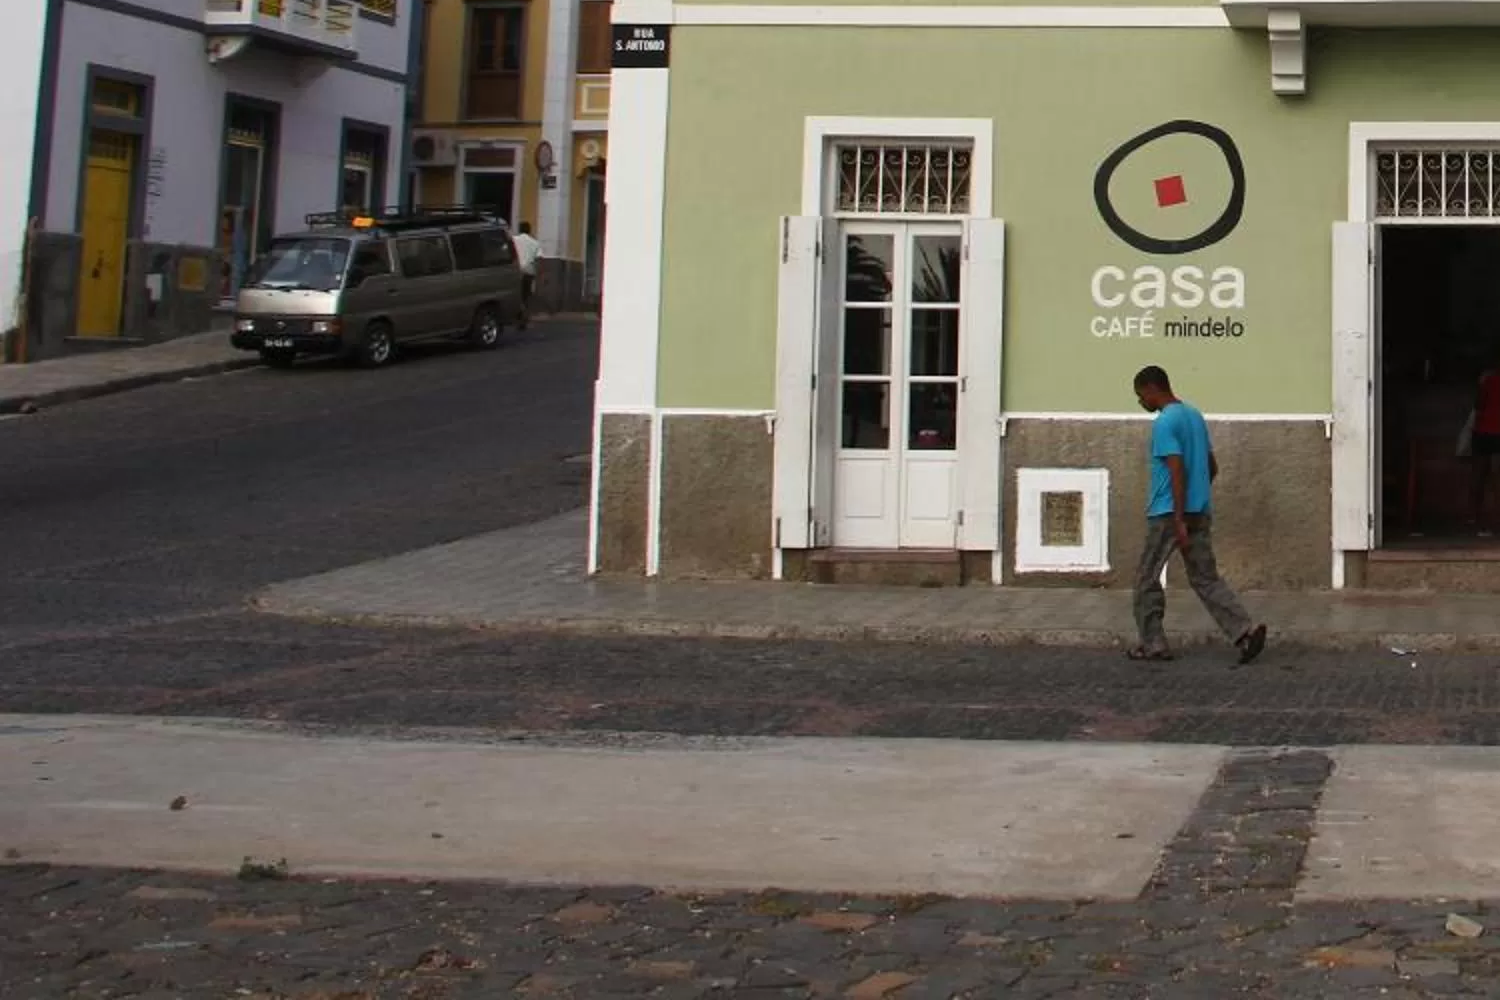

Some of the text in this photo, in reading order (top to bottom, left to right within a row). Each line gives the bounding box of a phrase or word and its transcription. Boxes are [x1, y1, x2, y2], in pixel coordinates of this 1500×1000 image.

[633, 27, 655, 39] RUA
[1091, 265, 1245, 308] casa
[1091, 310, 1244, 337] CAFÉ mindelo
